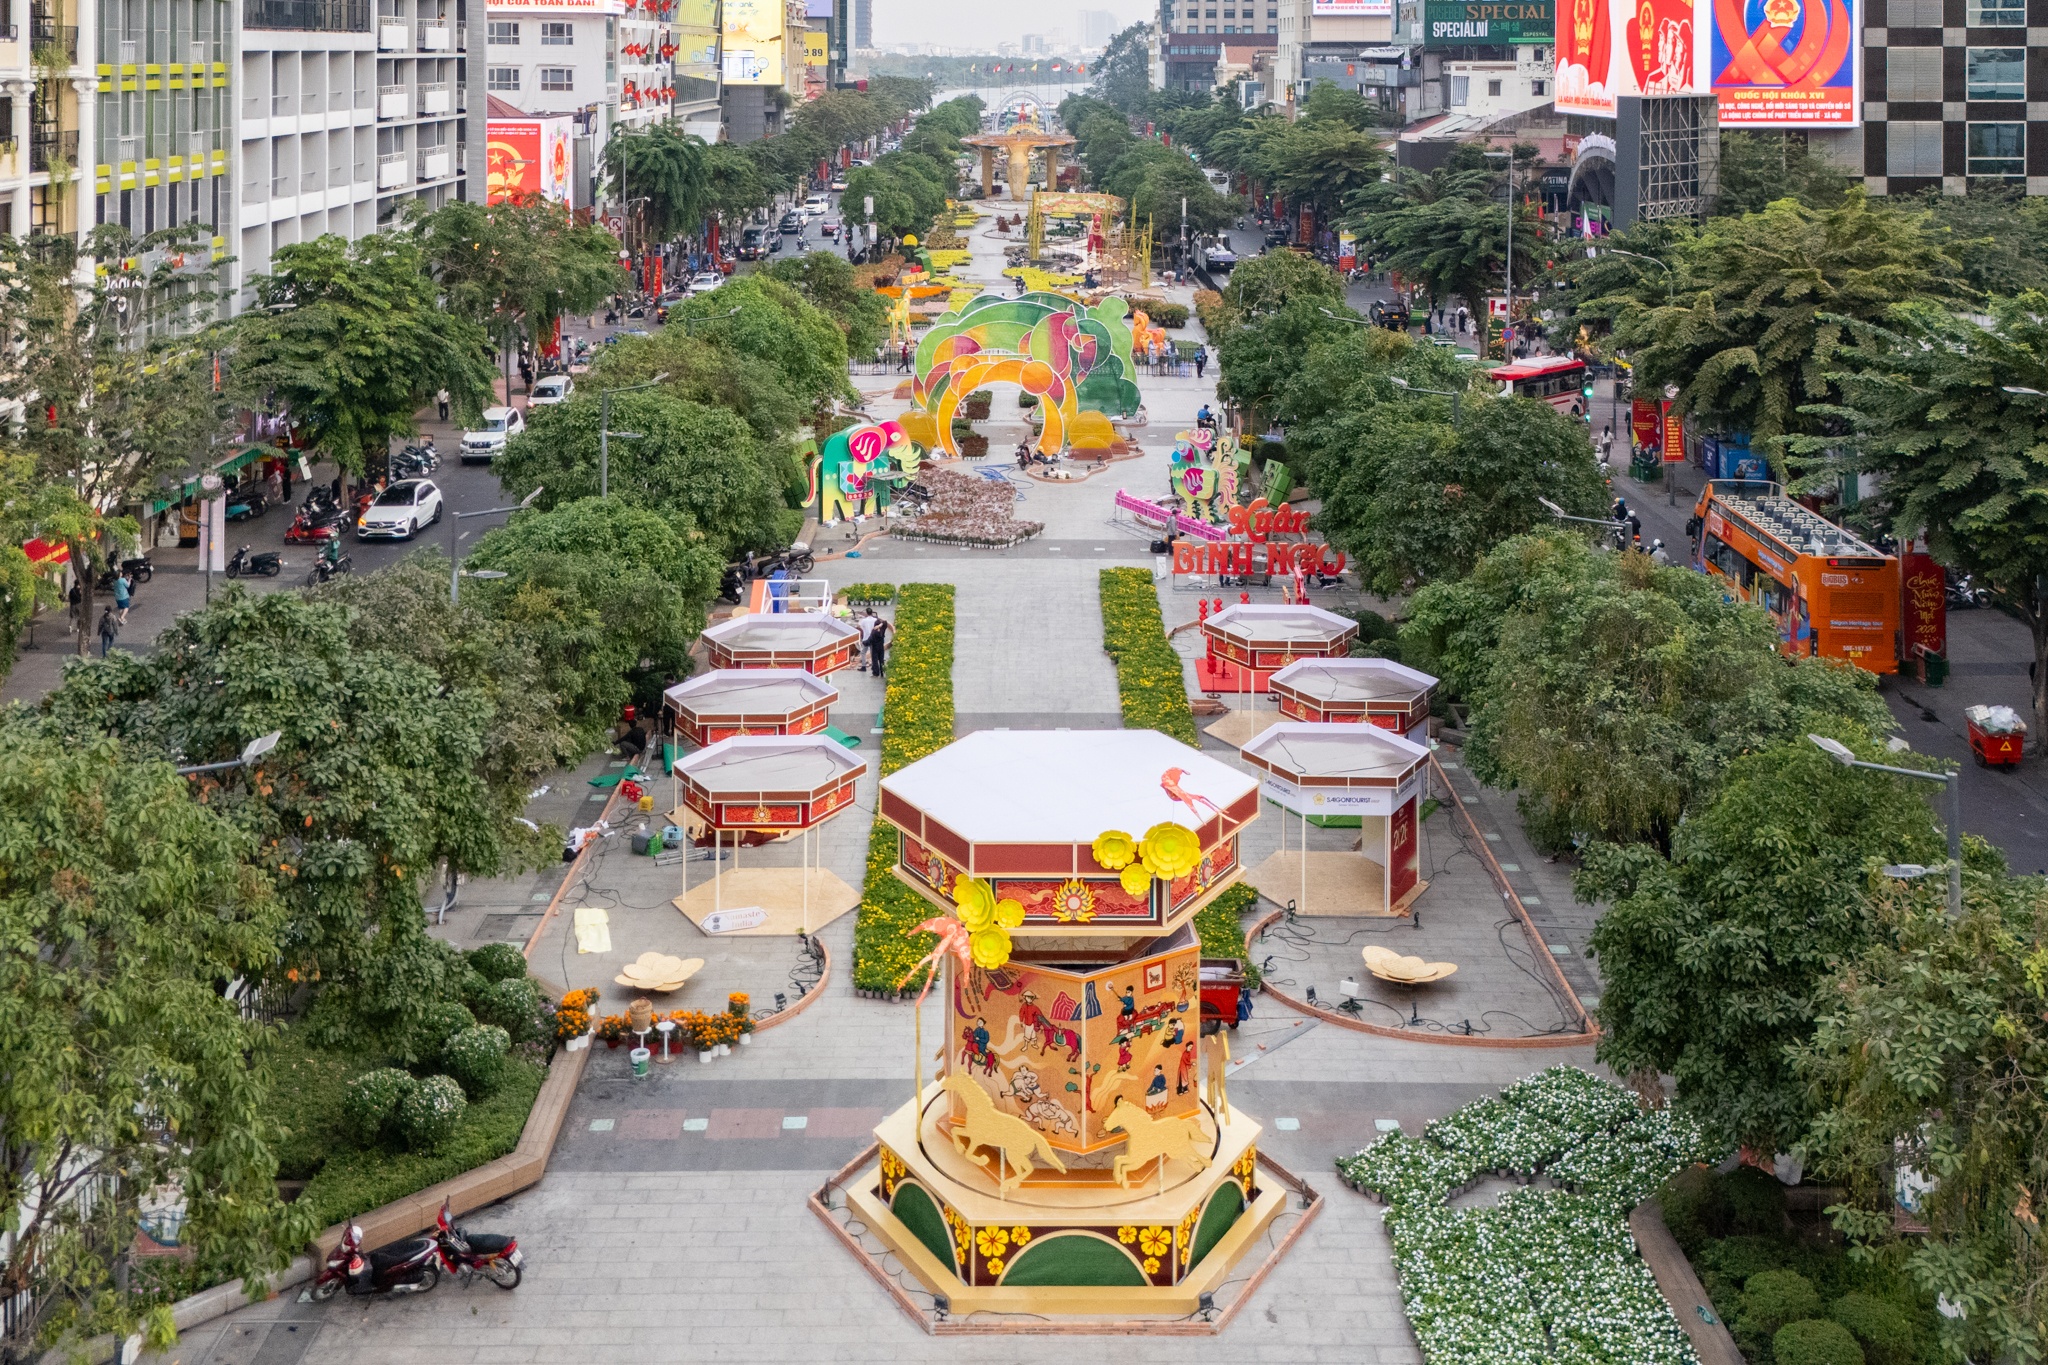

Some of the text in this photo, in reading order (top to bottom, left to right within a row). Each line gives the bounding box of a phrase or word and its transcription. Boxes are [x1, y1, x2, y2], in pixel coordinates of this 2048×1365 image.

[1428, 5, 1551, 20] POSEBEN SPECIAL
[1432, 20, 1489, 38] SPECIÁLNÍ
[1733, 90, 1825, 100] QUỐC HỘI KHÓA XVI
[1542, 176, 1568, 185] KATINA
[1228, 497, 1312, 543] Xuân
[1915, 624, 1937, 634] 2026
[725, 911, 761, 921] Namaste
[731, 920, 753, 929] India
